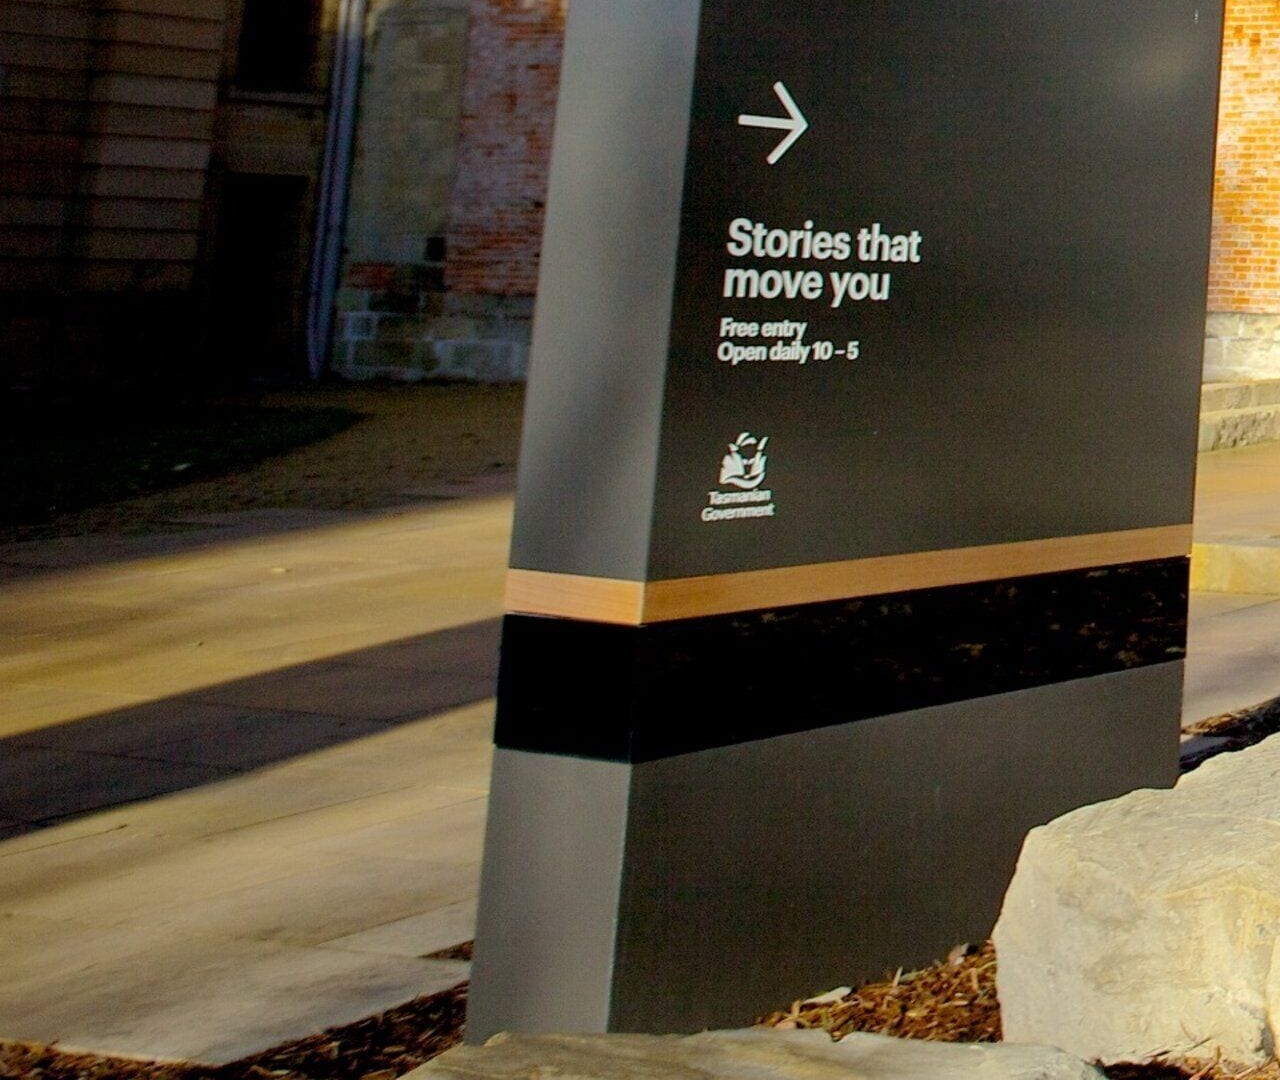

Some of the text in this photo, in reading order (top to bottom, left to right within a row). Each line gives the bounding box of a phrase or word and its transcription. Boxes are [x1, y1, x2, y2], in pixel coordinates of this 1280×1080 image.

[727, 218, 923, 263] Stories that
[723, 268, 891, 308] move you
[719, 317, 808, 341] Free entry
[717, 342, 767, 366] Open
[769, 340, 811, 365] daily
[708, 488, 772, 505] Tasmanian
[701, 503, 775, 521] Government
